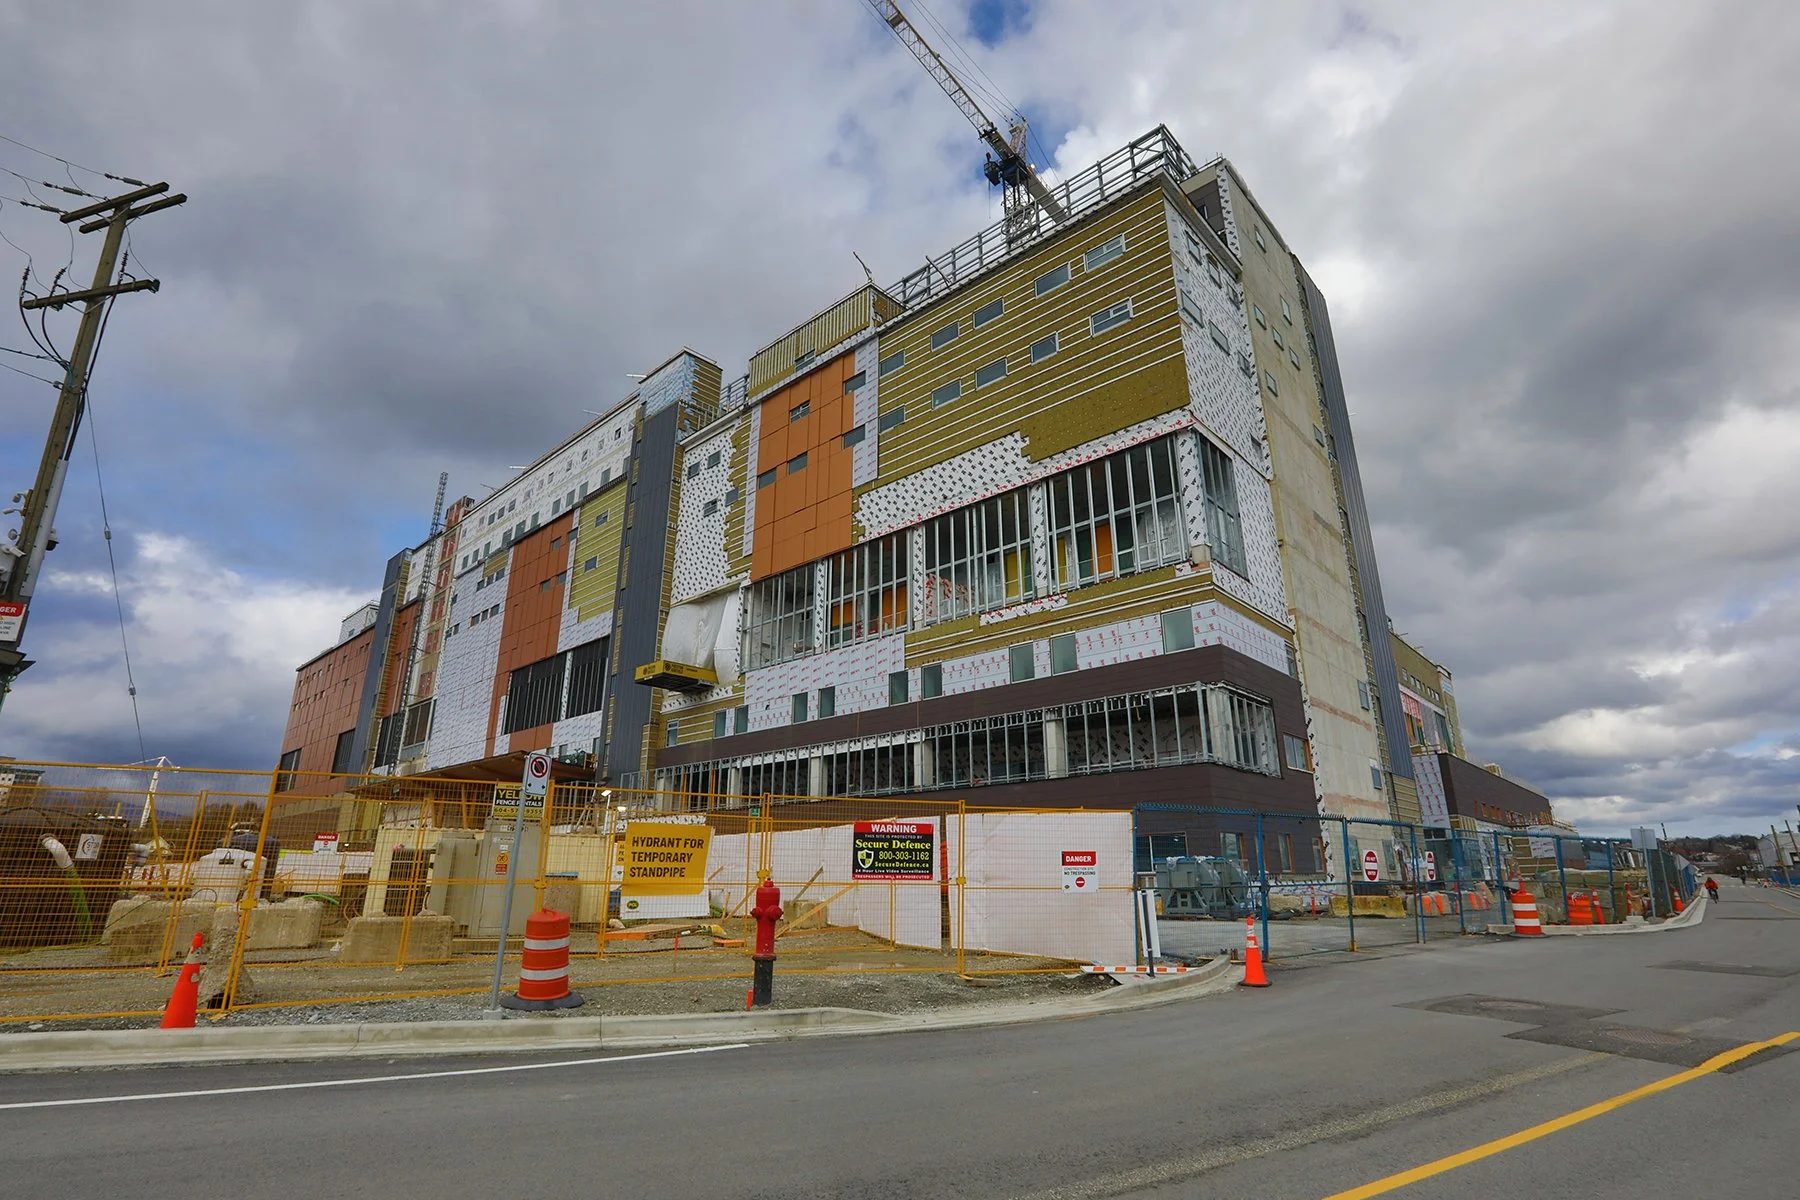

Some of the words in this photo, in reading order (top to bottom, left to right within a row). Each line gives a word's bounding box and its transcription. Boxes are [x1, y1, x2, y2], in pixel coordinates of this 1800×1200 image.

[871, 824, 917, 833] WARNING
[632, 836, 682, 848] HYDRANT
[684, 839, 704, 849] FOR
[855, 839, 889, 848] Secure
[892, 840, 931, 849] Defence
[631, 851, 693, 863] TEMPORARY
[879, 851, 929, 860] 800-303-1162
[629, 866, 686, 878] STANDPIPE
